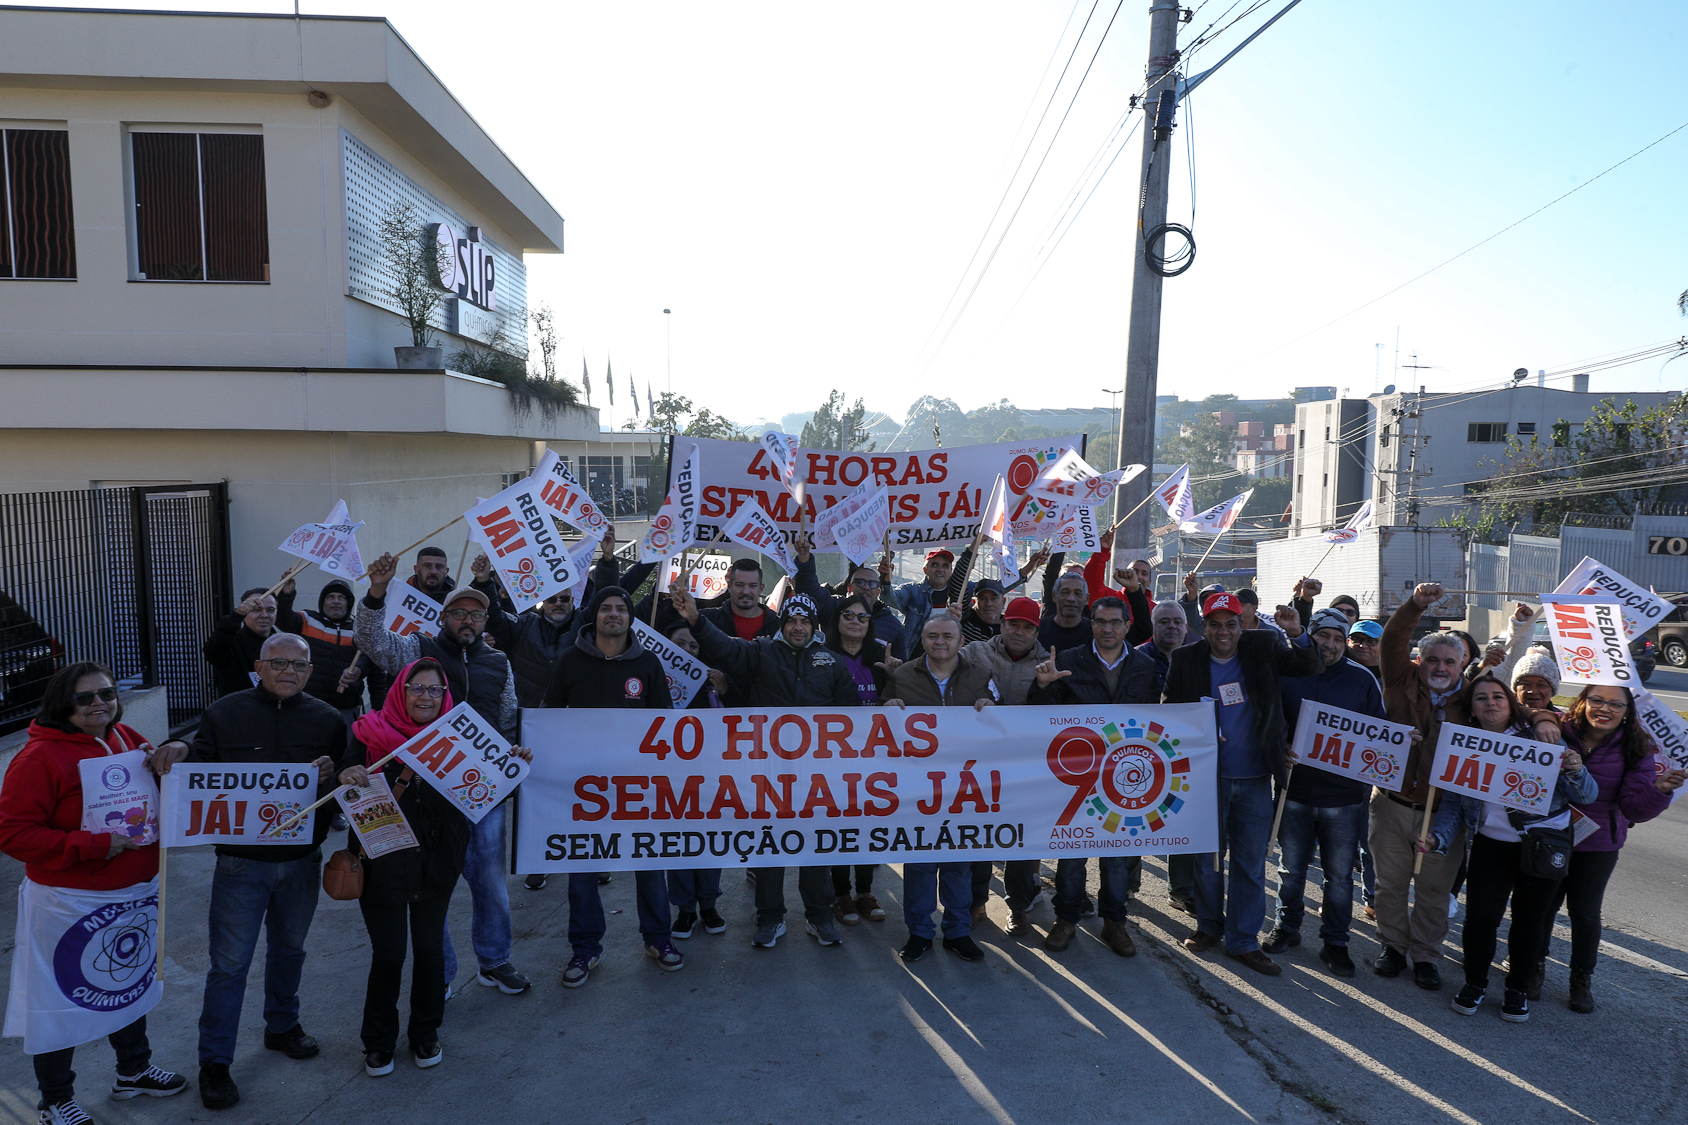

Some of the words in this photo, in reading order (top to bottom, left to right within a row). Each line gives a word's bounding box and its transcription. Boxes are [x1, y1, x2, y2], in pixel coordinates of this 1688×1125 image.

[806, 452, 948, 487] HORAS
[928, 482, 982, 520] JÁ!
[476, 492, 569, 583] REDUÇÃO
[477, 506, 528, 559] JÁ!
[736, 522, 772, 548] JÁ!
[1650, 537, 1688, 556] 70
[1589, 570, 1661, 618] REDUÇÃO
[1552, 602, 1594, 641] JÁ!
[635, 629, 702, 681] REDUÇÃO
[1594, 606, 1631, 681] REDUÇÃO
[639, 715, 704, 761] 40
[722, 713, 939, 760] HORAS
[1050, 717, 1081, 725] RUMO
[1085, 716, 1106, 725] AOS
[1316, 711, 1405, 746] REDUÇÃO
[406, 729, 467, 780] JÁ!
[447, 713, 520, 779] EDUÇÃO
[1111, 746, 1155, 763] QUÍMICOS
[1307, 733, 1356, 769] JÁ!
[1450, 732, 1554, 766] REDUÇÃO
[188, 768, 310, 794] REDUÇÃO
[572, 772, 900, 821] SEMANAIS
[917, 760, 1001, 814] JÁ!
[1439, 754, 1496, 793] JÁ!
[185, 794, 248, 837] JÁ!
[1050, 827, 1095, 839] ANOS
[545, 833, 622, 860] SEM
[632, 826, 805, 863] REDUÇÃO
[815, 829, 860, 853] DE
[869, 820, 1024, 852] SALÁRIO!
[1049, 839, 1131, 849] CONSTRUINDO
[1135, 839, 1143, 847] O
[1145, 837, 1189, 847] FUTURO
[72, 980, 144, 1007] QUÍMICAS
